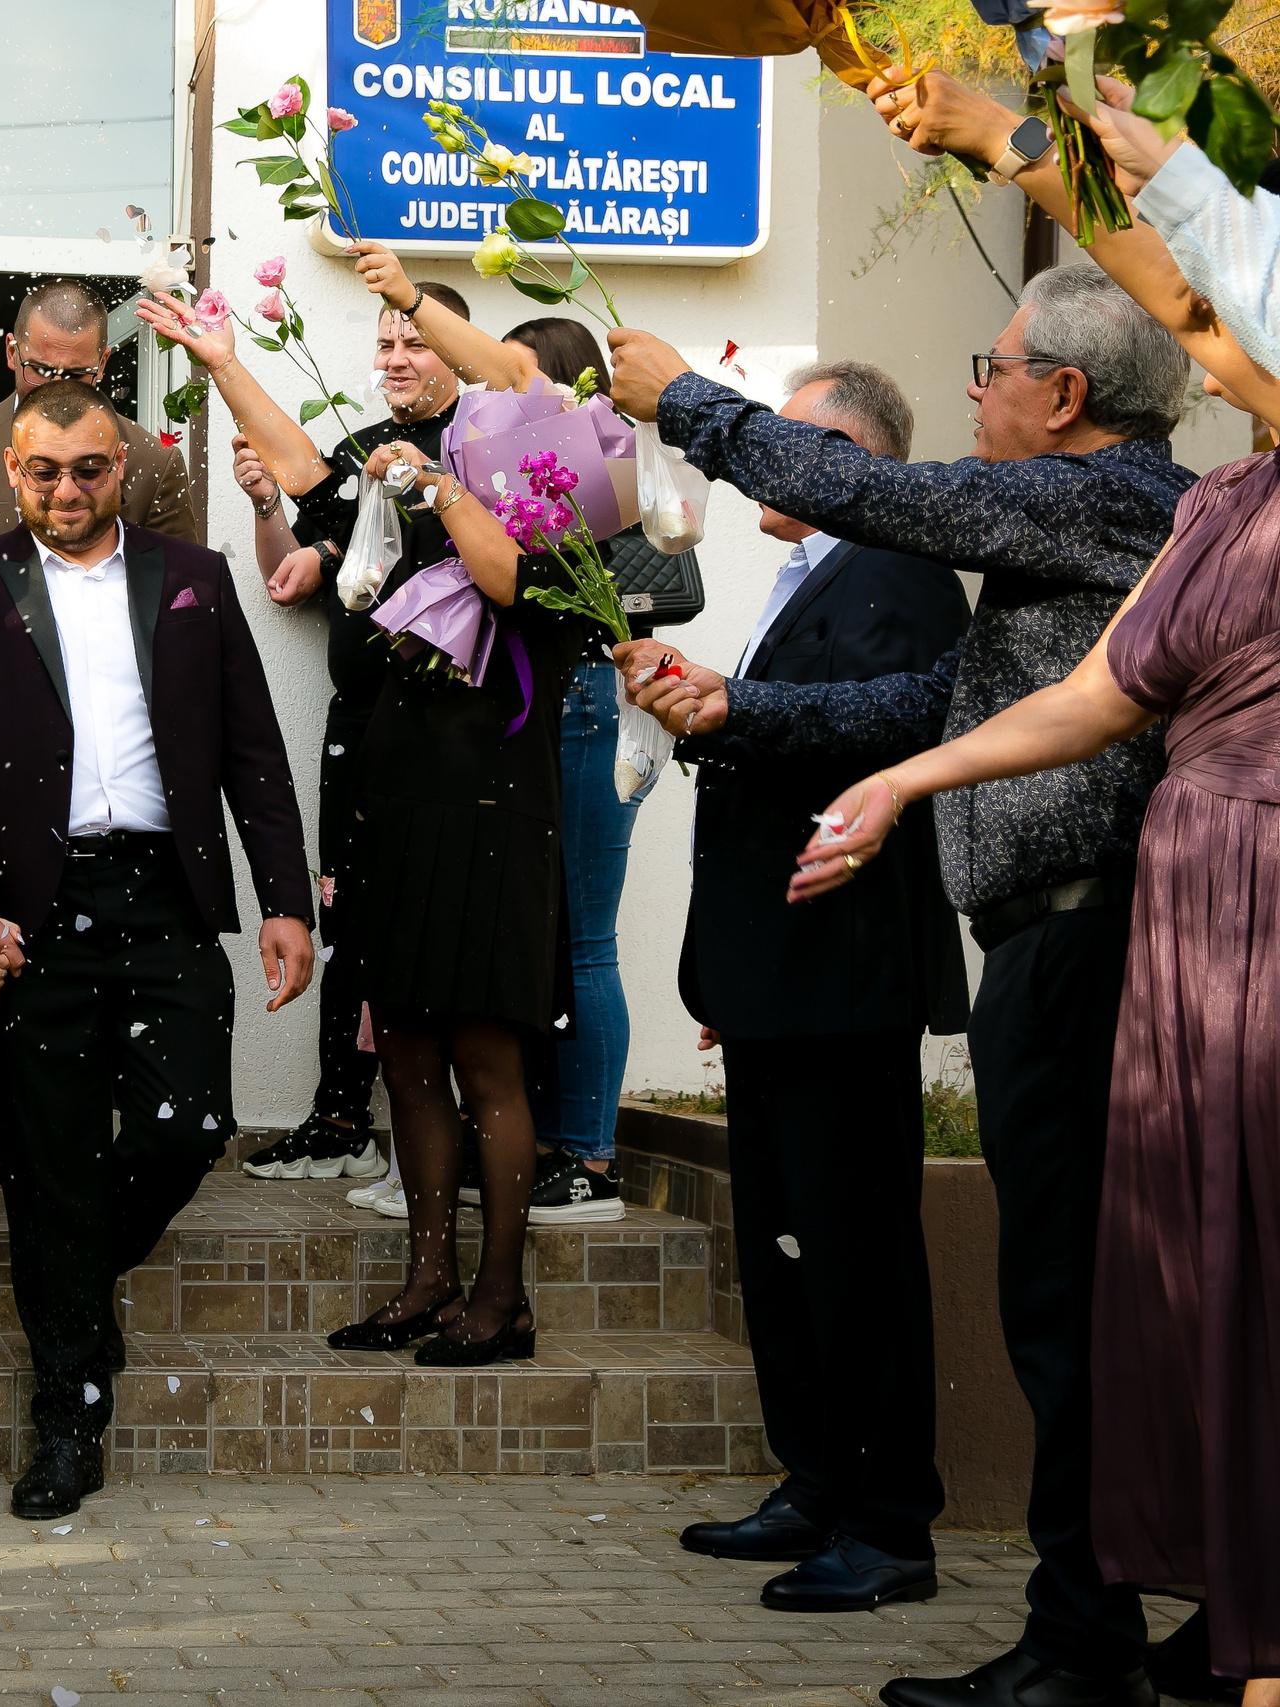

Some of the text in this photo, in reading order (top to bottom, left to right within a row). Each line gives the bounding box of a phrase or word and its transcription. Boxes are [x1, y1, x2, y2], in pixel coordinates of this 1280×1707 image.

[353, 62, 736, 109] CONSILIUL LOCAL
[525, 113, 565, 142] AL
[527, 150, 708, 204] PLĂTĂREȘTI
[553, 199, 690, 244] ĂLĂRAȘI
